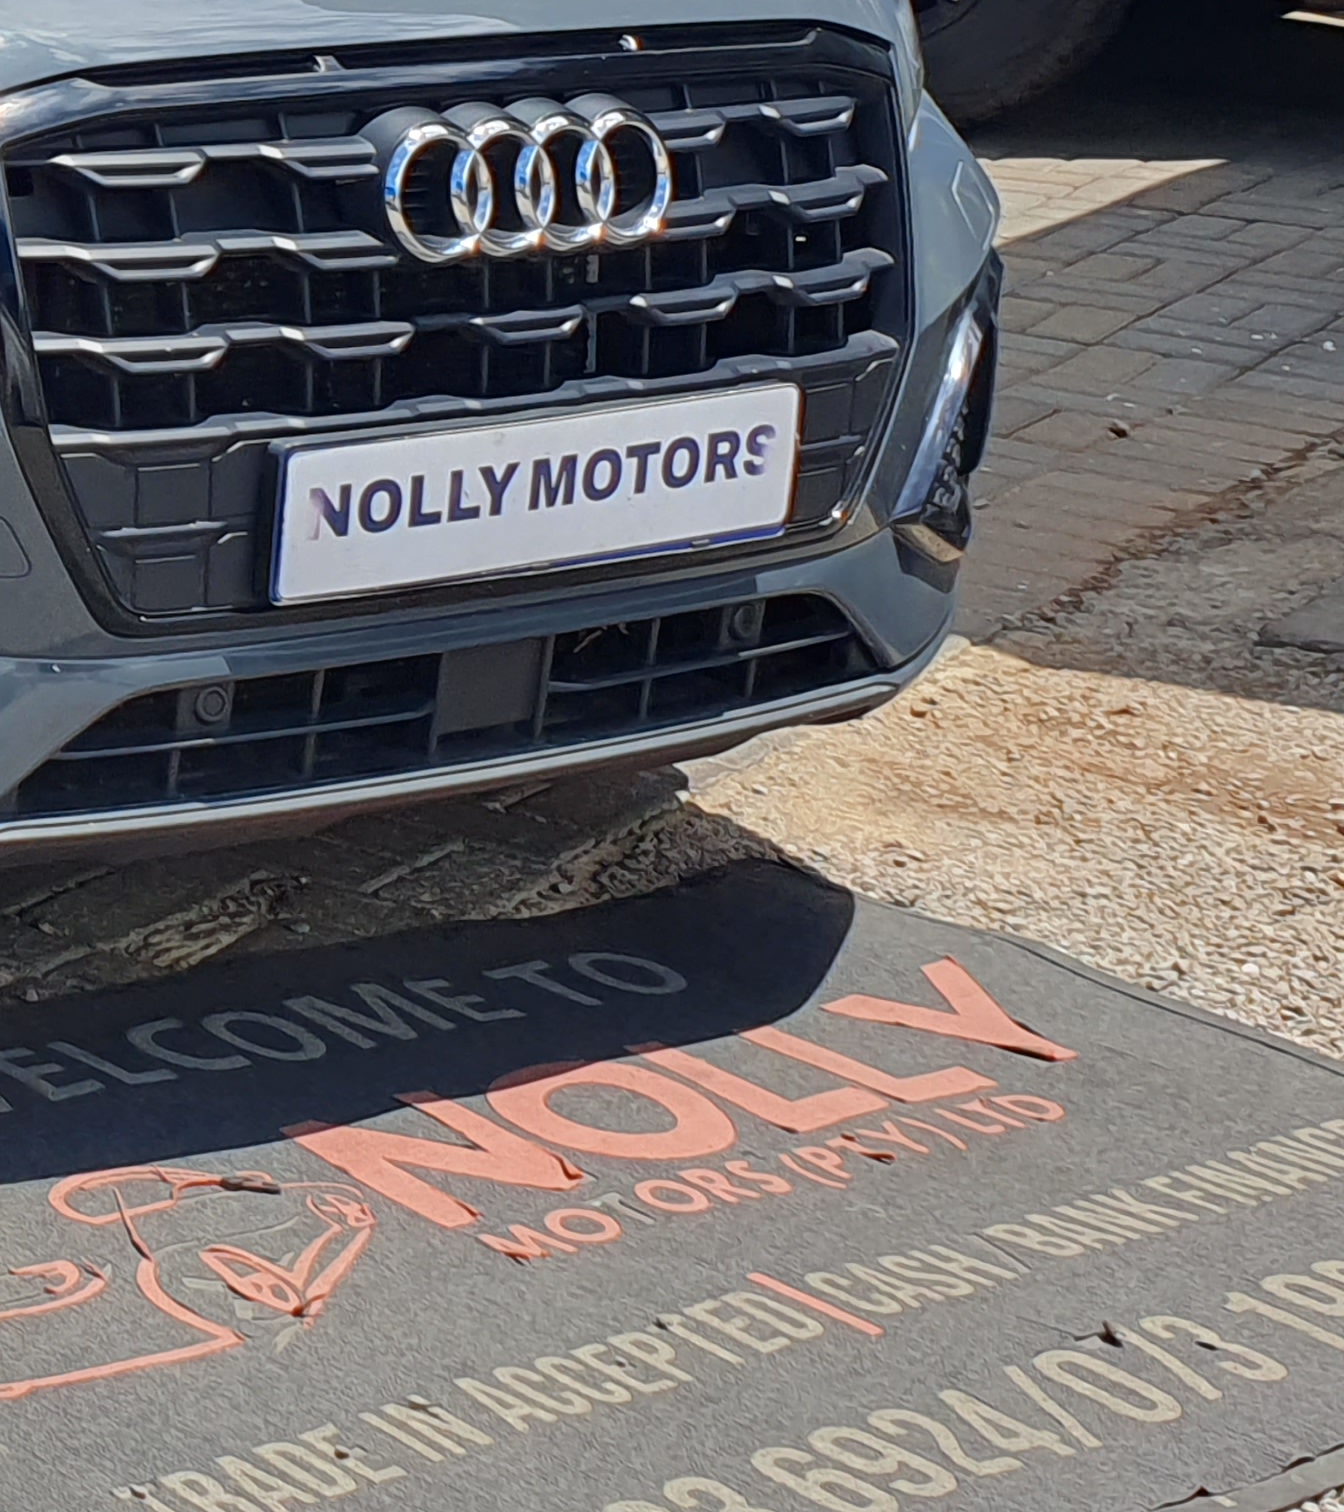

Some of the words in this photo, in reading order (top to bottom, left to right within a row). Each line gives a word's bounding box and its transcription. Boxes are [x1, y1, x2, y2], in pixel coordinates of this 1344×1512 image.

[309, 461, 519, 541] NOLLY
[527, 424, 777, 510] MOTORS
[489, 951, 688, 1007] TO
[280, 955, 1079, 1229] NOLLY
[478, 1160, 793, 1259] MOTORS
[935, 1094, 1065, 1134] LTD
[358, 1394, 494, 1462] IN
[453, 1289, 825, 1432] ACCEPTED
